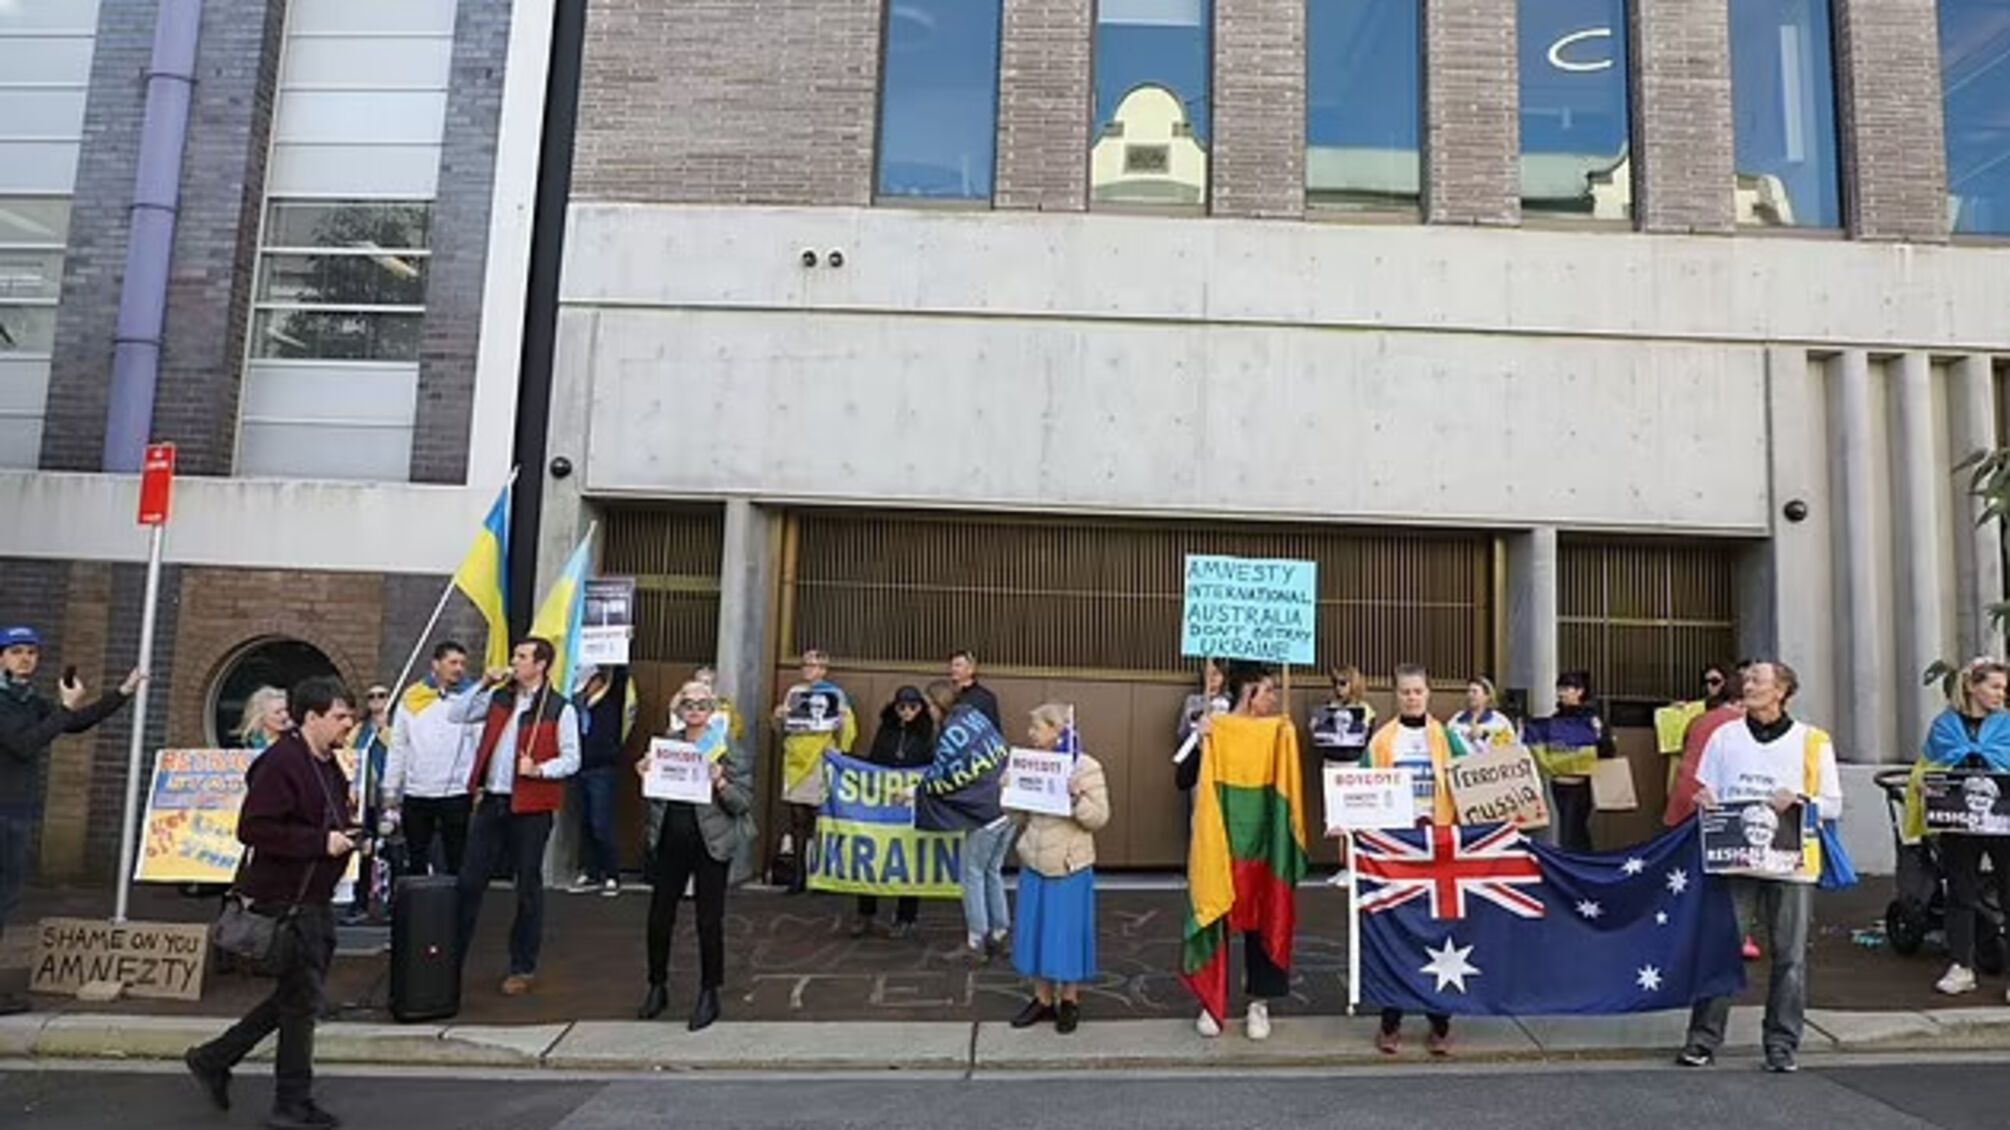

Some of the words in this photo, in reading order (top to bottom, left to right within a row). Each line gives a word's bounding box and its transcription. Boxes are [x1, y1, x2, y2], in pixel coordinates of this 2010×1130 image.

[1187, 560, 1296, 584] AMNESTY
[1187, 583, 1313, 606] INTERNATIONAL
[1187, 602, 1303, 627] AUSTRALIA
[1199, 637, 1291, 661] UKRAINE
[43, 927, 125, 950] SHAME
[130, 932, 159, 950] ON
[163, 933, 199, 955] YOU
[35, 955, 198, 991] AMNEZTY
